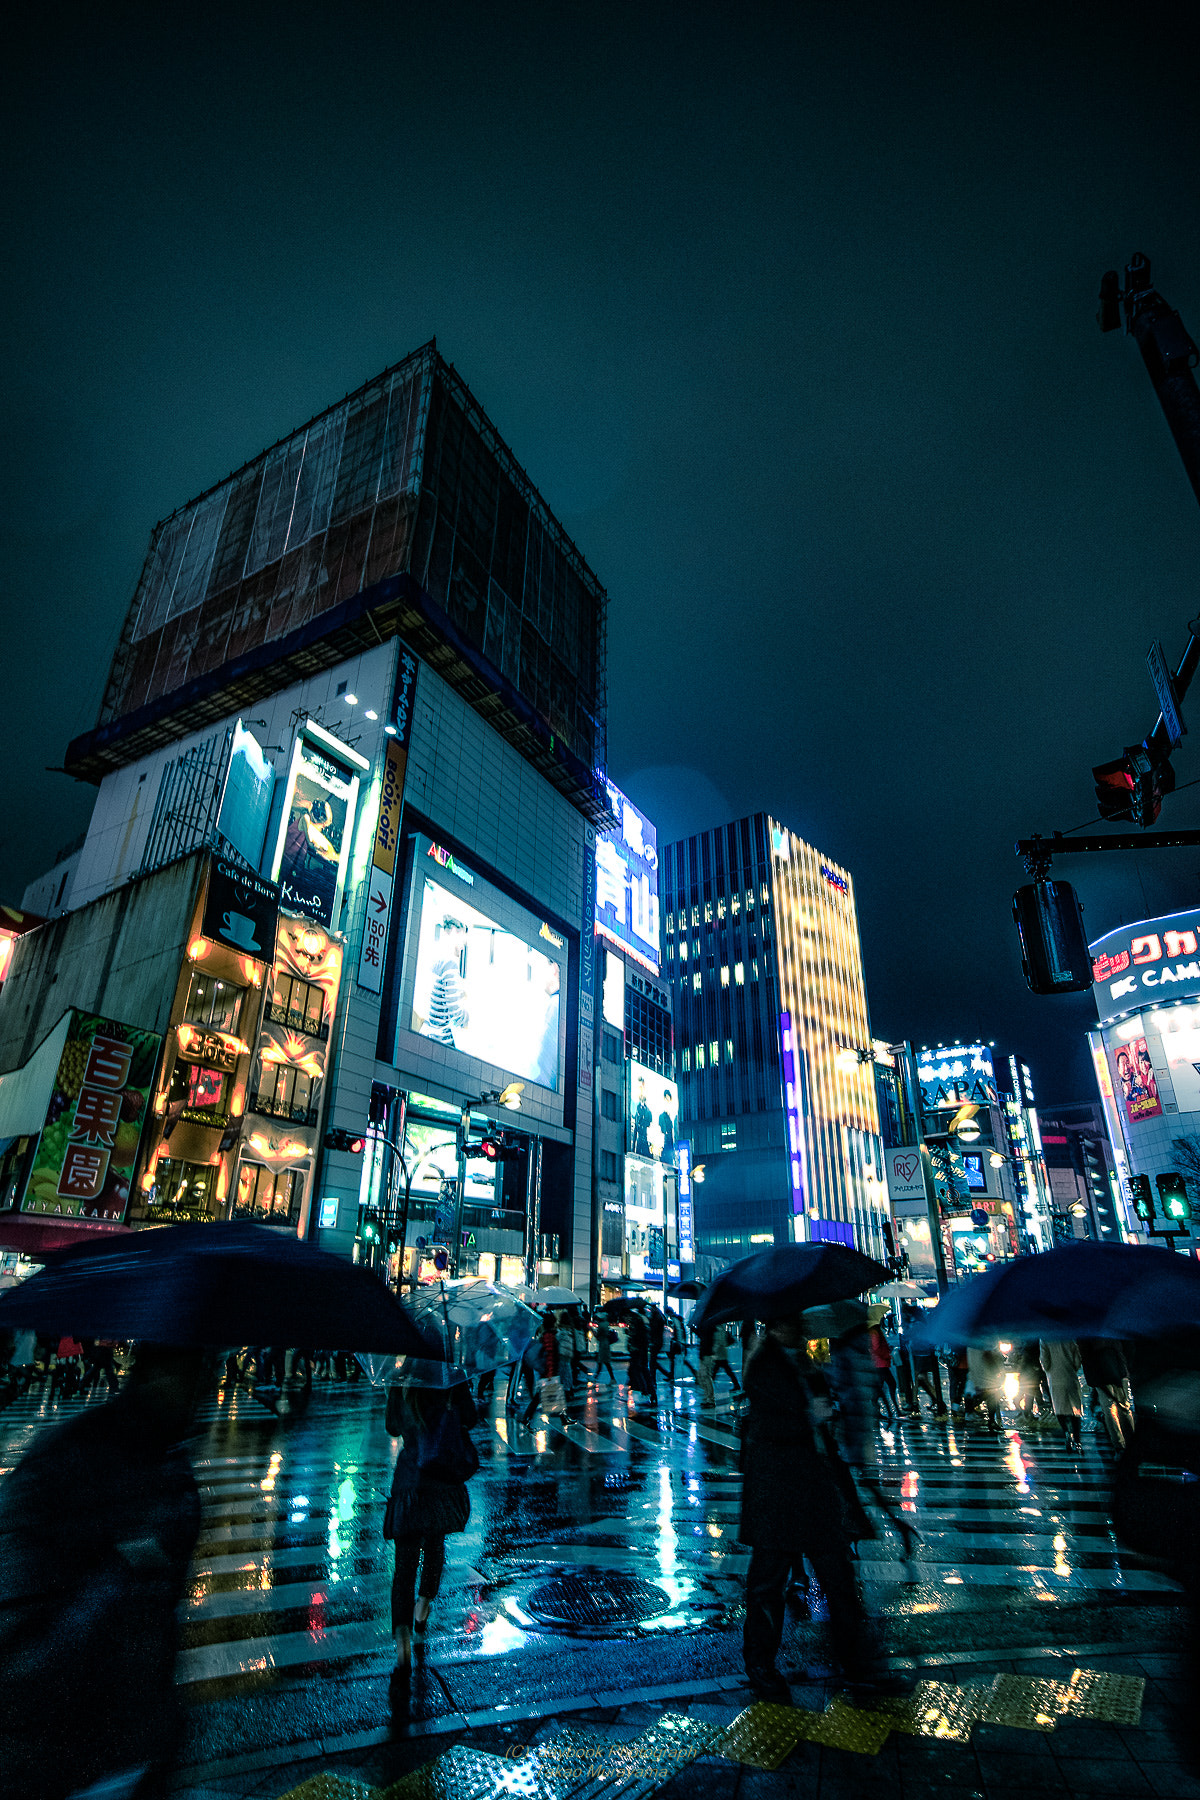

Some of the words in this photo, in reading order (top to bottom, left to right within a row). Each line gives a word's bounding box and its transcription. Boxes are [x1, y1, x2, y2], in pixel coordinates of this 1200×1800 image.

[427, 841, 456, 871] ALTA
[217, 862, 240, 881] Cafe
[241, 874, 253, 889] de
[254, 880, 276, 900] Bore
[595, 835, 661, 954] 青山
[1092, 926, 1200, 983] ビックカ
[1141, 960, 1200, 987] CAM
[56, 1033, 135, 1200] 百果園
[27, 1200, 121, 1220] HYAKKAEN
